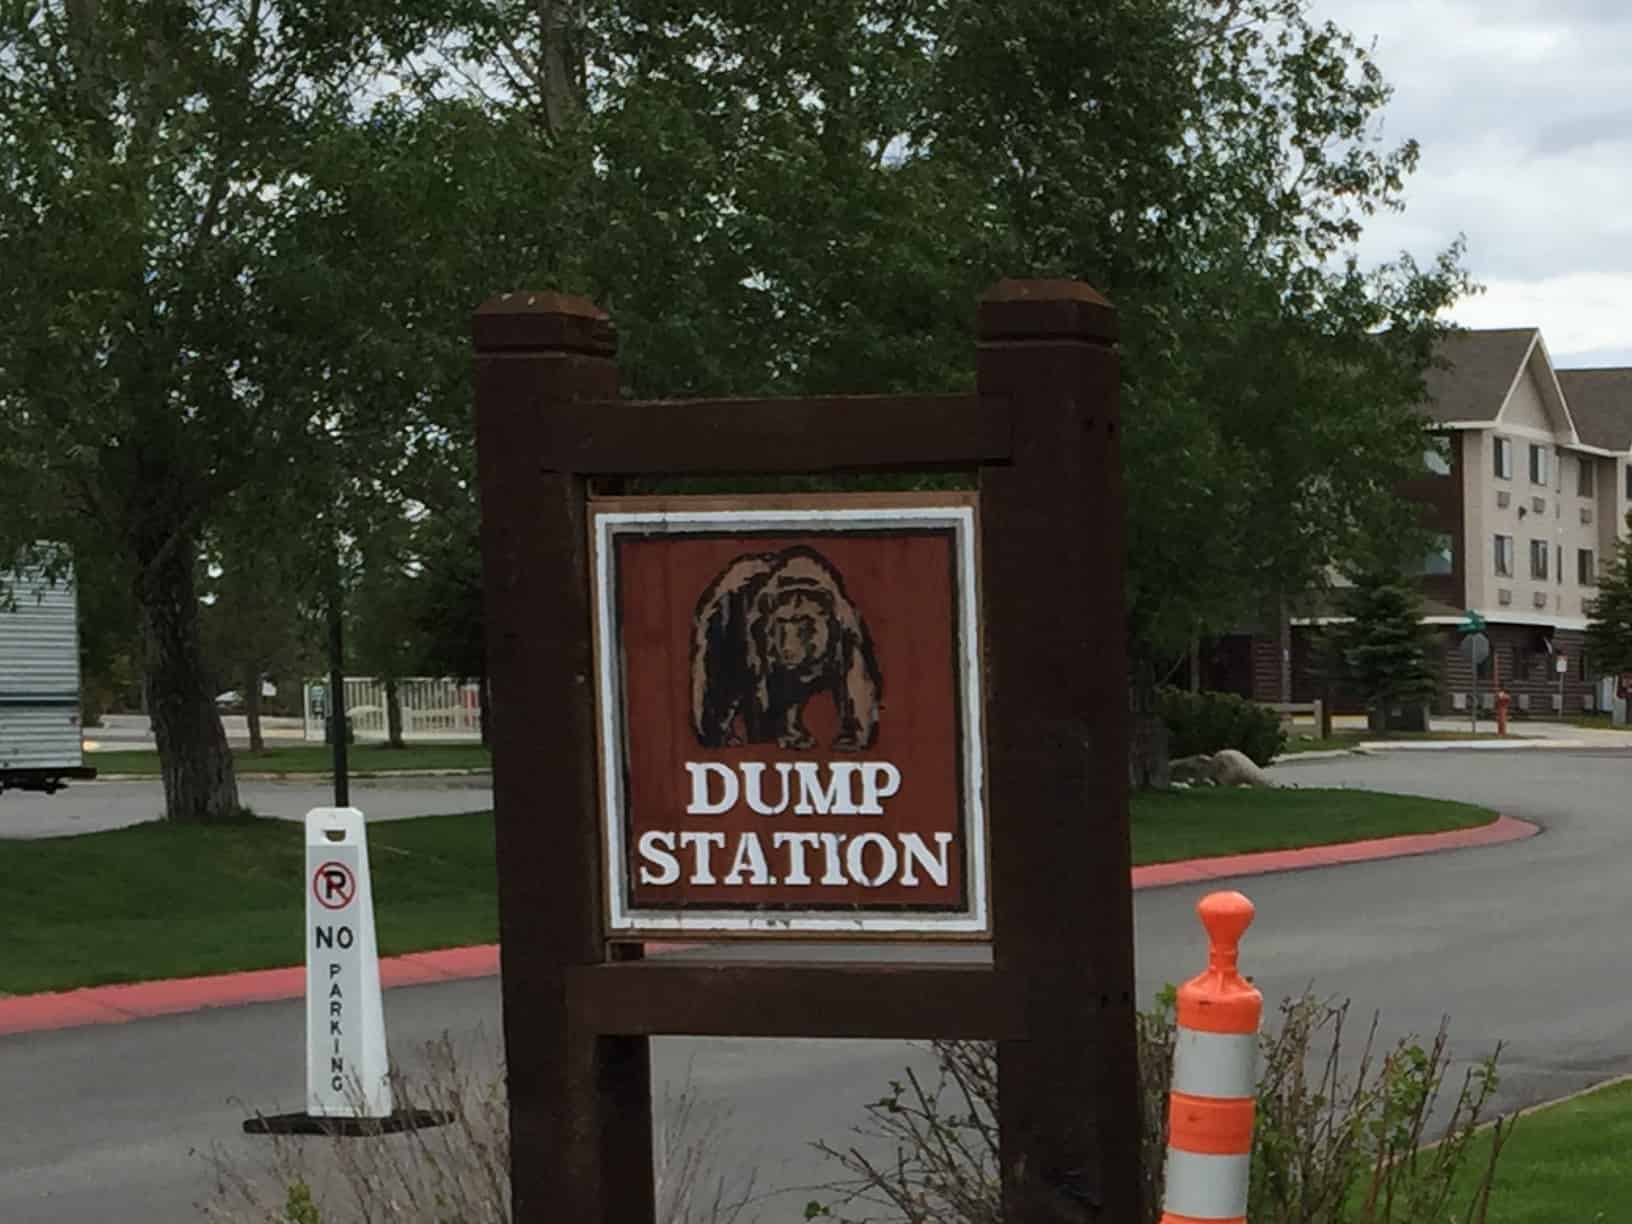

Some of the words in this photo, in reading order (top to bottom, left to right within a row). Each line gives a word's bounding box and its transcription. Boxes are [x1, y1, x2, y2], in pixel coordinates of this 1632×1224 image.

[685, 761, 901, 816] DUMP
[638, 831, 952, 886] STATION
[315, 926, 354, 949] NO
[329, 964, 343, 1091] PARKING
